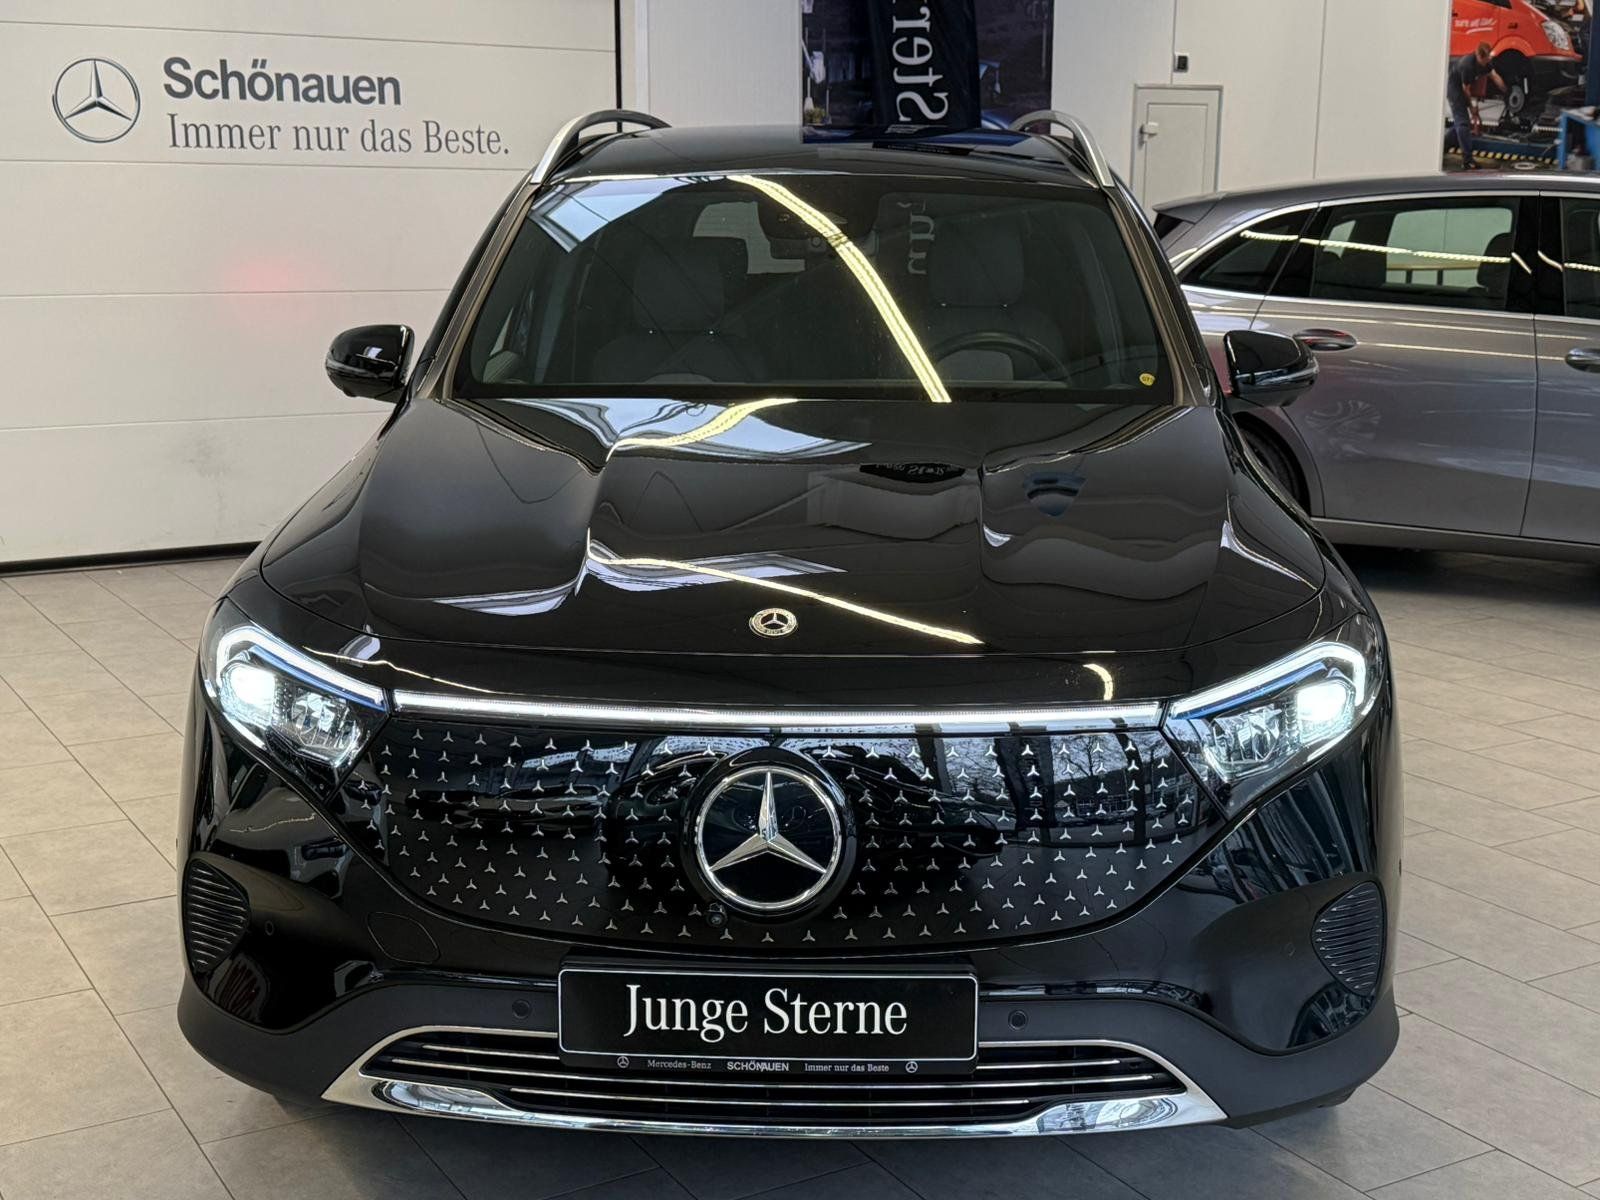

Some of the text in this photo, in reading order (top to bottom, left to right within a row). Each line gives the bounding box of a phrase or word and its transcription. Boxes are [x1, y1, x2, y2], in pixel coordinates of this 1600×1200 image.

[163, 56, 401, 106] Schönauen
[167, 113, 509, 155] Immer nur das Beste.
[623, 984, 907, 1043] Junge Sterne
[647, 1059, 712, 1069] Mercedes-Benz
[727, 1060, 789, 1072] SCHÖNAUEN
[804, 1063, 890, 1073] Immer nur das Beste
